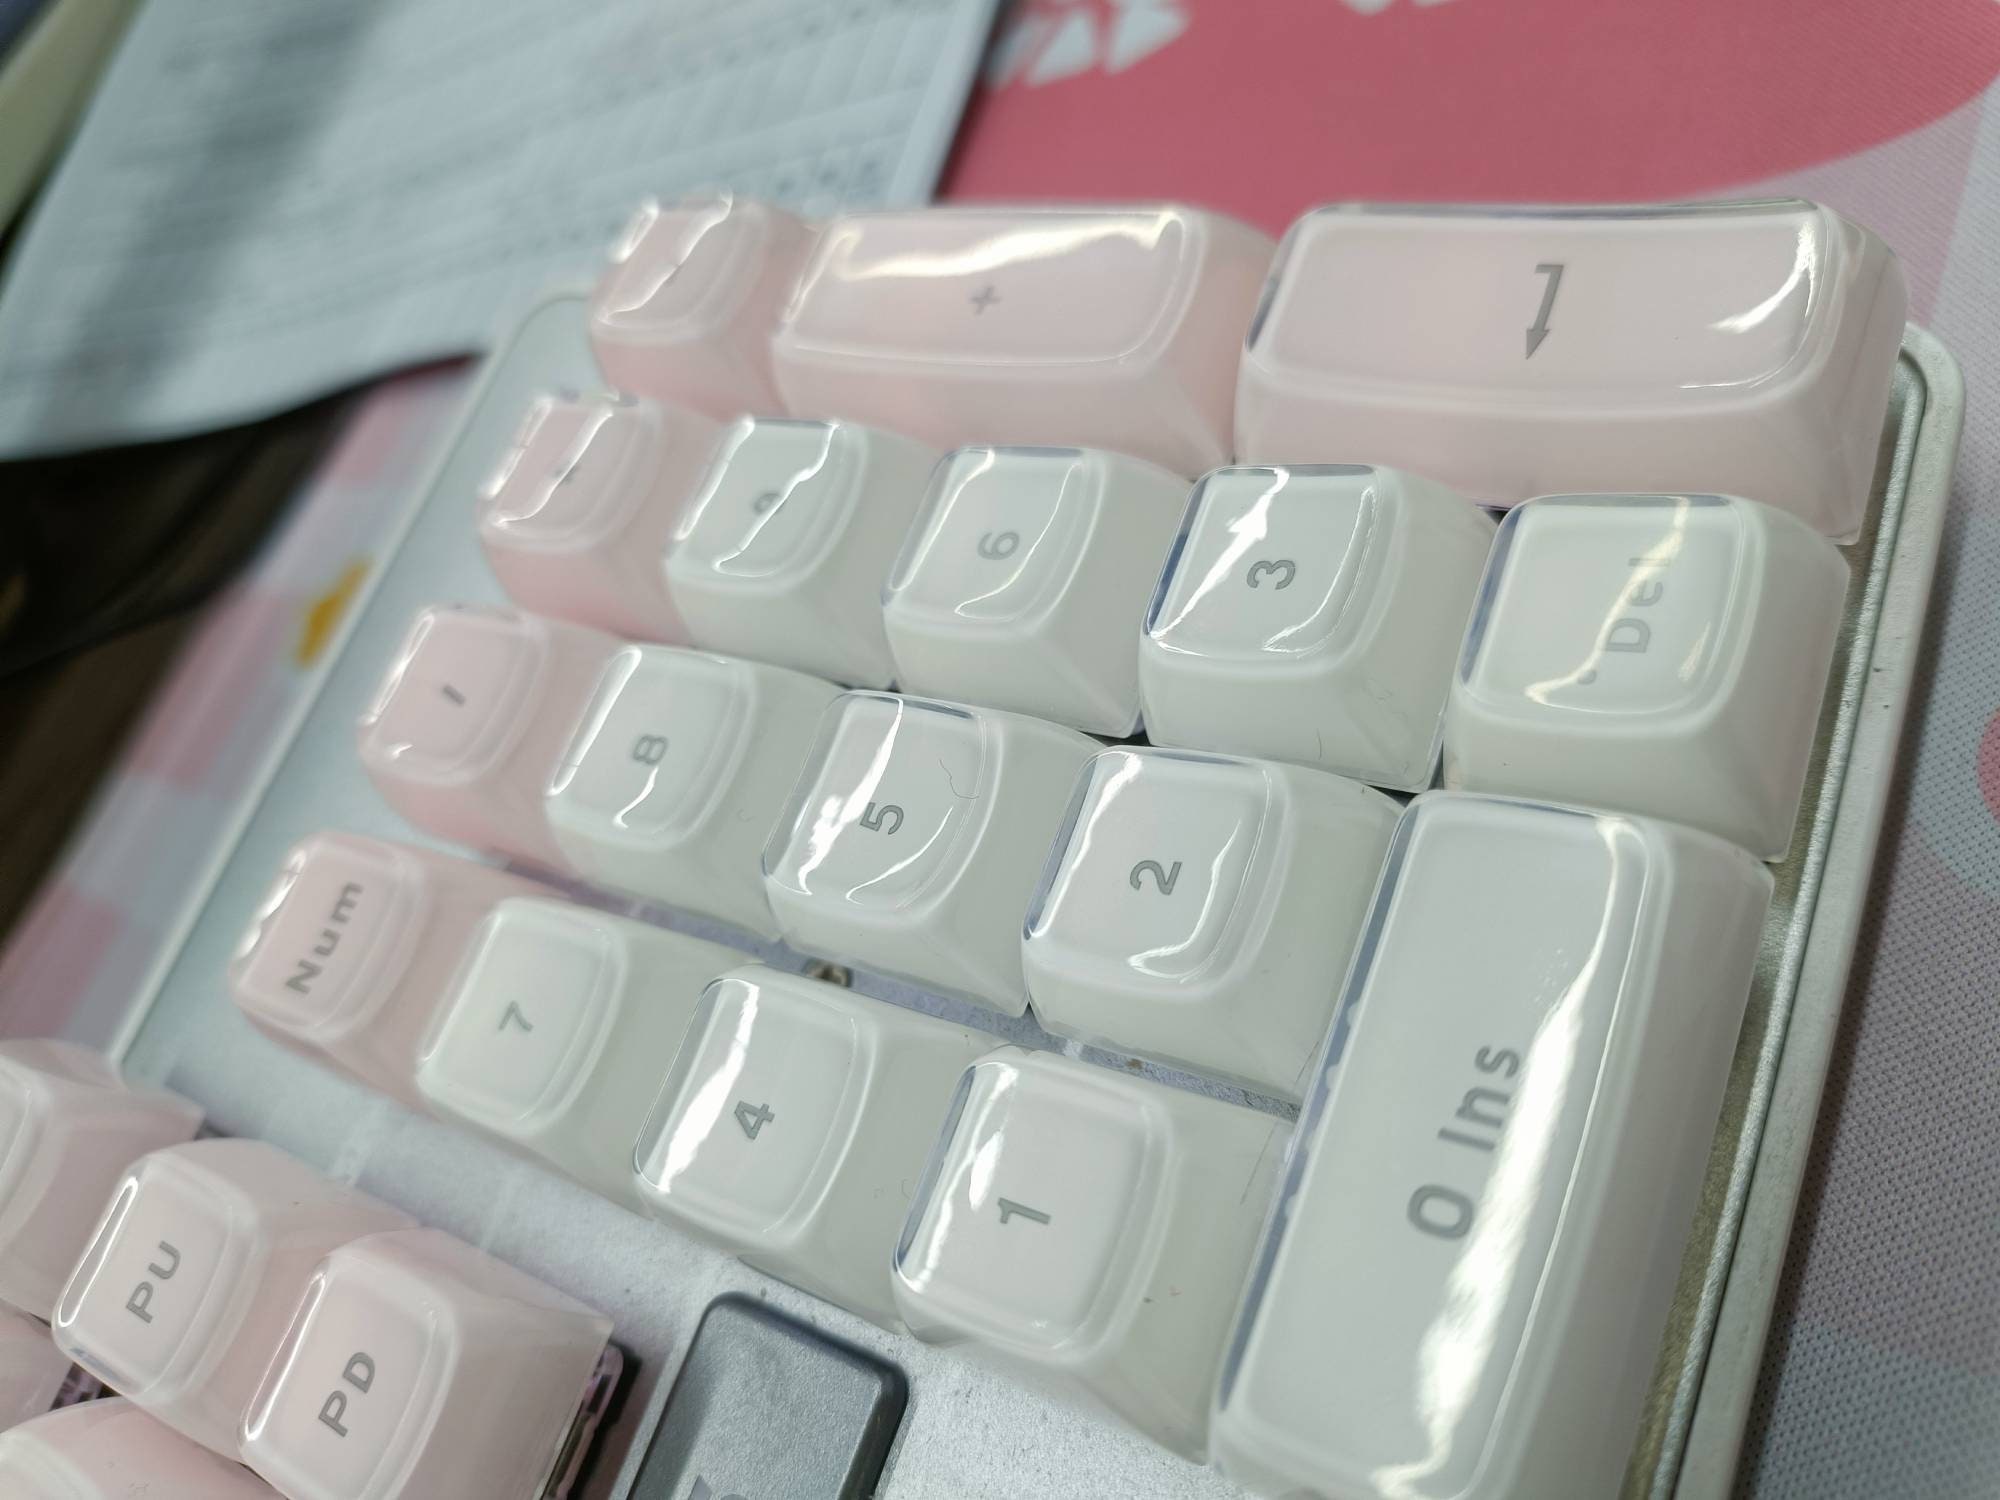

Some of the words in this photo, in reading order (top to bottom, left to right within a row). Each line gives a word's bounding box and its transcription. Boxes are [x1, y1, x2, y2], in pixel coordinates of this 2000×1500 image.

[977, 530, 1020, 561] 6
[1246, 558, 1296, 590] 3
[1605, 557, 1671, 654] Del
[632, 733, 669, 766] 8
[859, 800, 905, 836] 5
[1129, 859, 1183, 896] 2
[284, 880, 364, 995] Num
[499, 1001, 534, 1032] 7
[1437, 1043, 1522, 1152] Ins
[734, 1100, 776, 1140] 4
[997, 1197, 1052, 1226] 1
[125, 1240, 182, 1324] PU
[318, 1350, 378, 1438] PD
